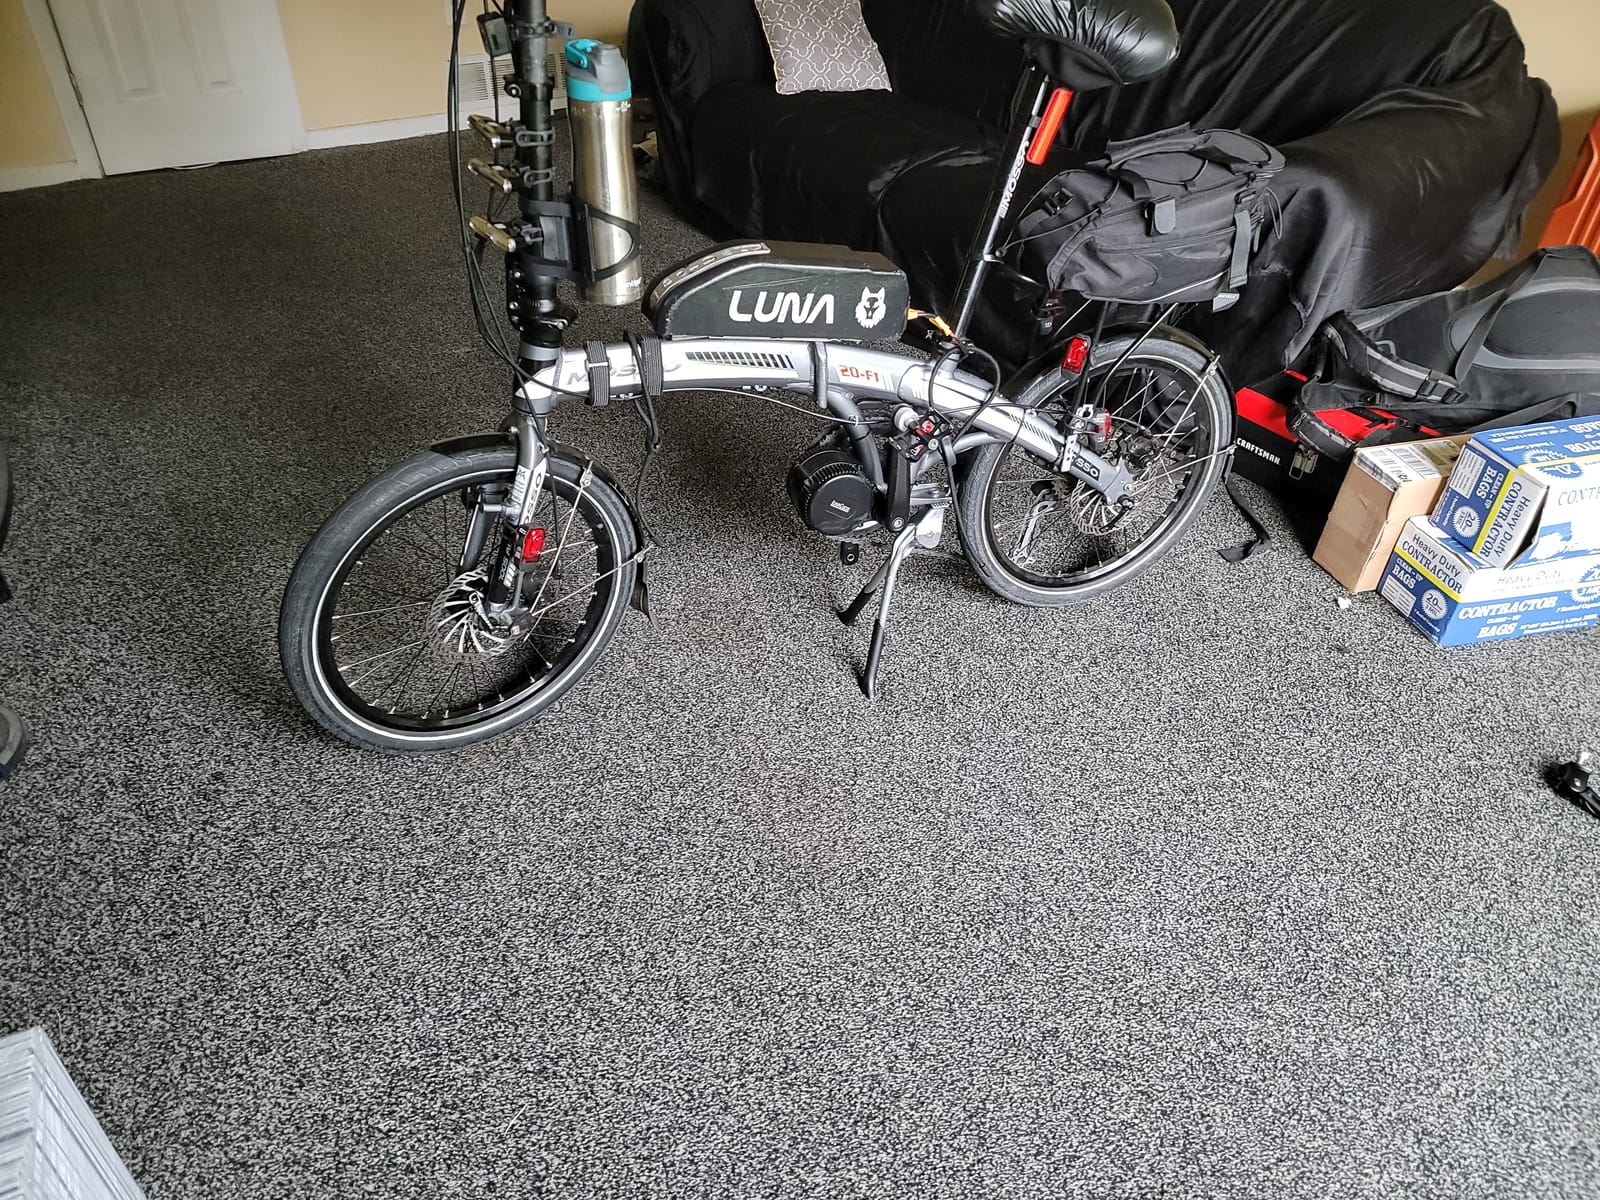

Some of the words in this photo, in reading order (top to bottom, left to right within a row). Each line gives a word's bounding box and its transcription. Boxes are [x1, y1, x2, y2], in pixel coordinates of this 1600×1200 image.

[728, 290, 835, 325] LUNA
[567, 361, 682, 386] MSO
[839, 364, 880, 383] 20-F1
[1236, 437, 1281, 465] CRAFTSMAN
[1476, 466, 1496, 499] BAGS
[1463, 513, 1476, 527] 20
[1482, 482, 1523, 559] CONTRACTOR
[1507, 497, 1531, 530] Heavy
[1412, 534, 1437, 559] Heavy
[1439, 555, 1461, 578] Duty
[1495, 530, 1512, 557] Duty
[1392, 565, 1416, 589] BAGS
[1402, 541, 1462, 594] CONTRACTOR
[1426, 594, 1439, 606] 20
[1458, 596, 1559, 620] CONTRACTOR
[1477, 623, 1518, 639] BAGS
